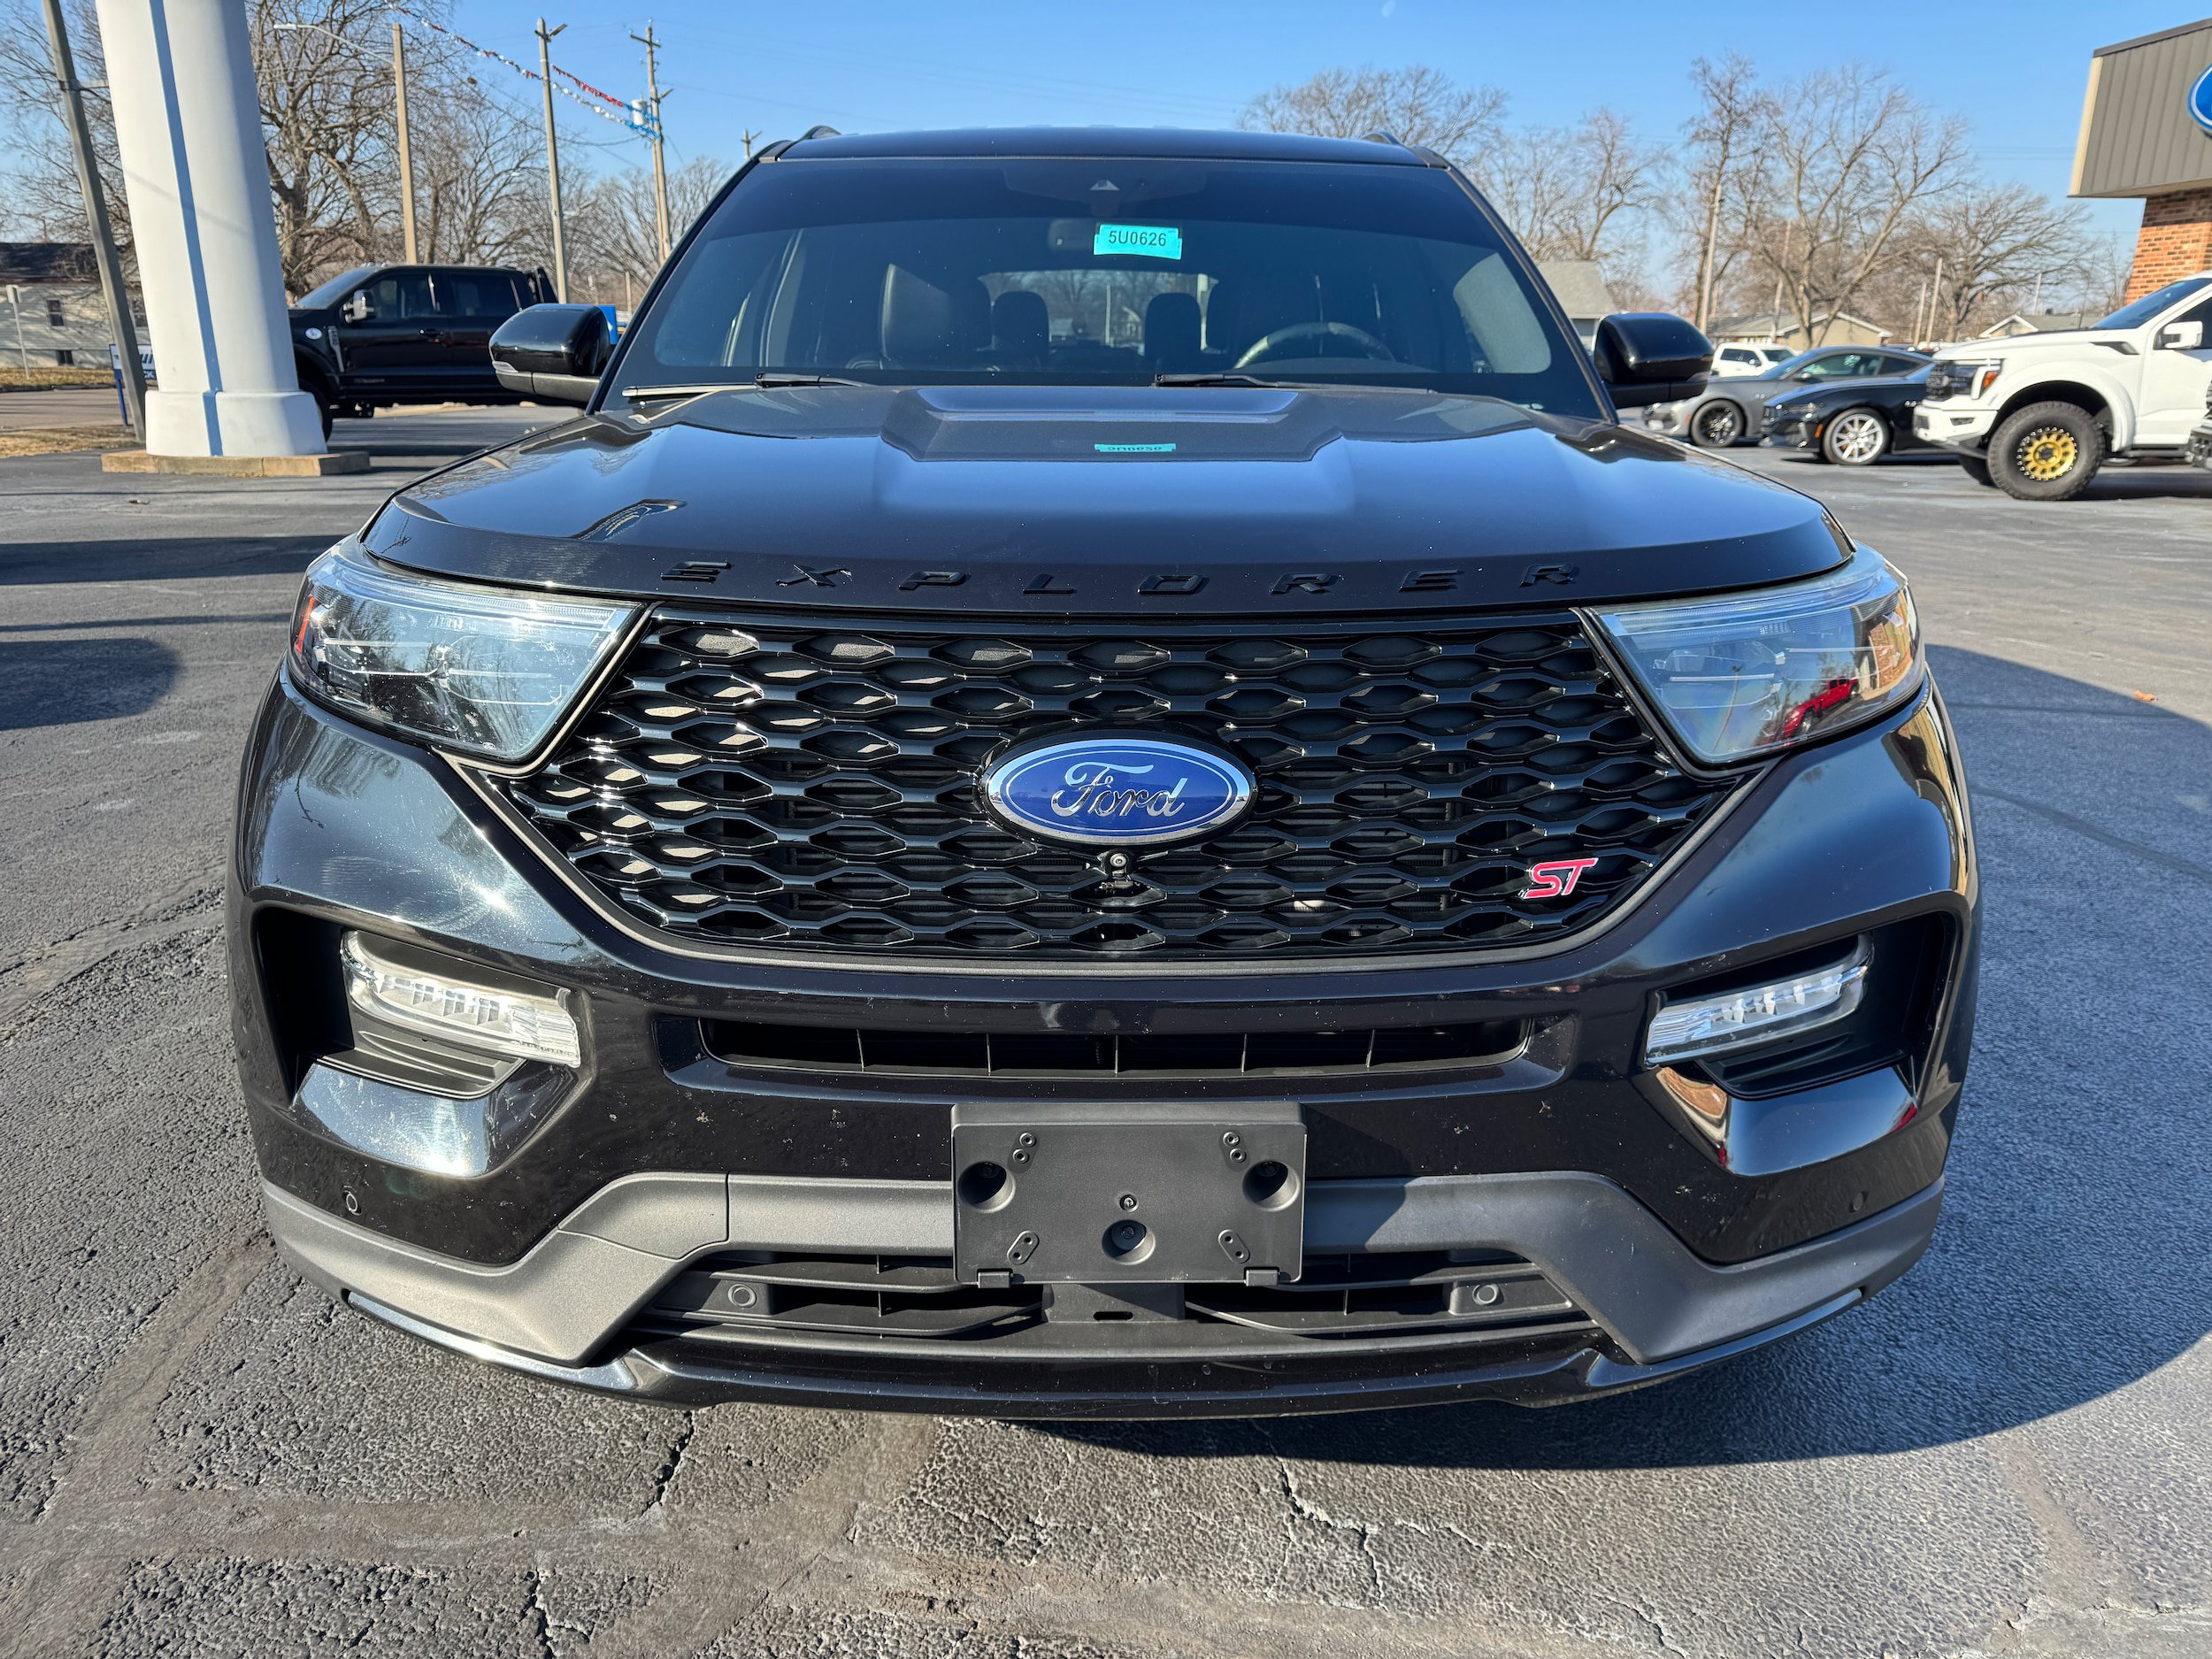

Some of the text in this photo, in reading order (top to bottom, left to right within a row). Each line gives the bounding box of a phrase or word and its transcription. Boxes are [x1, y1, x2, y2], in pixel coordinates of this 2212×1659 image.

[1108, 230, 1167, 247] 5U0626
[660, 561, 1575, 594] EXPLORER
[1050, 761, 1188, 817] Ford
[1524, 857, 1599, 899] ST
